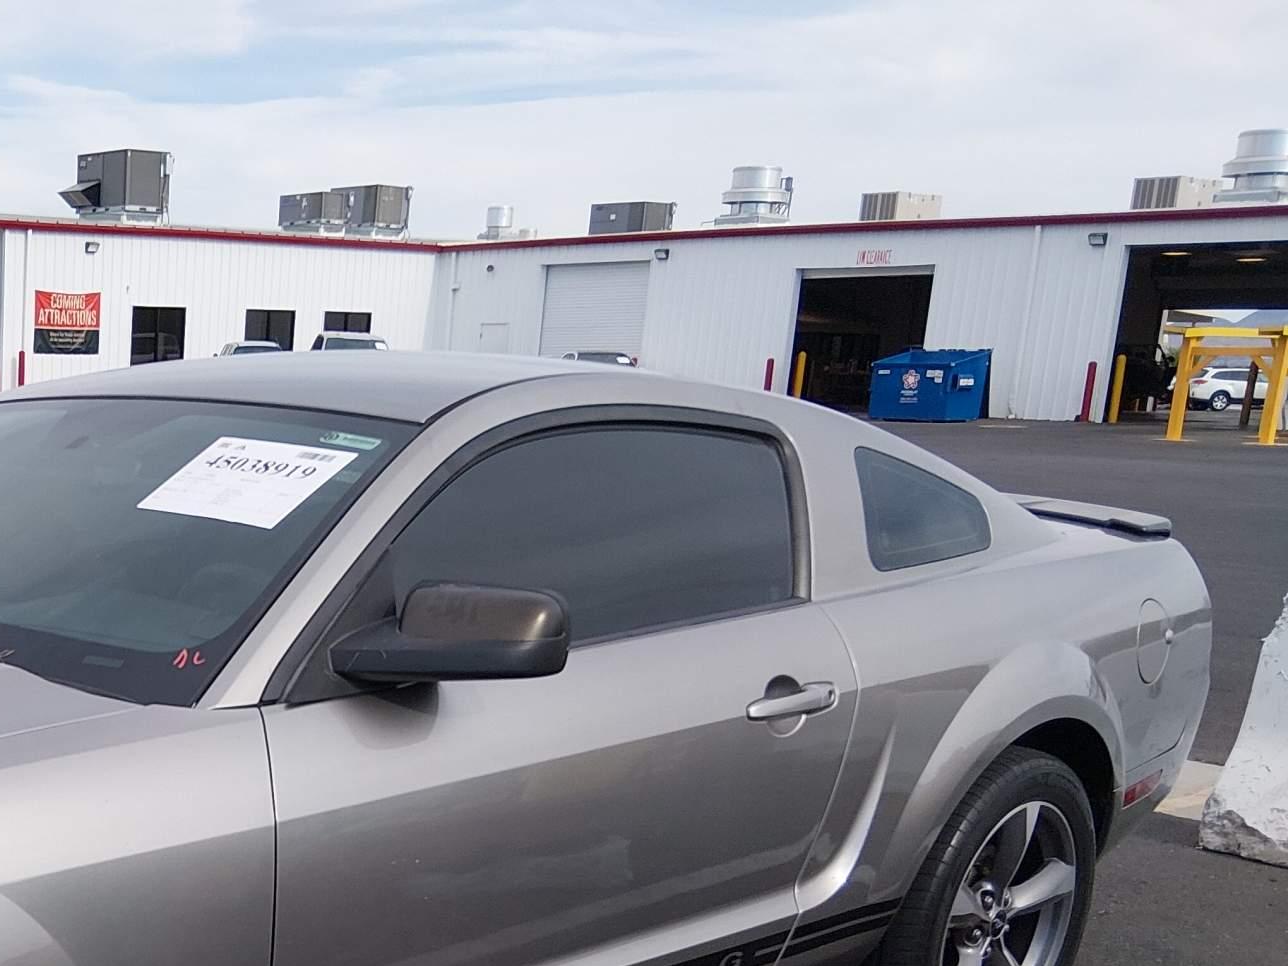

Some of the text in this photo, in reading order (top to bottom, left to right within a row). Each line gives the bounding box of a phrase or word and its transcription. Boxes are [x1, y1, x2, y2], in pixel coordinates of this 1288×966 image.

[50, 293, 86, 310] COMING
[38, 308, 97, 326] ATTRACTIONS
[205, 454, 318, 480] 45038919
